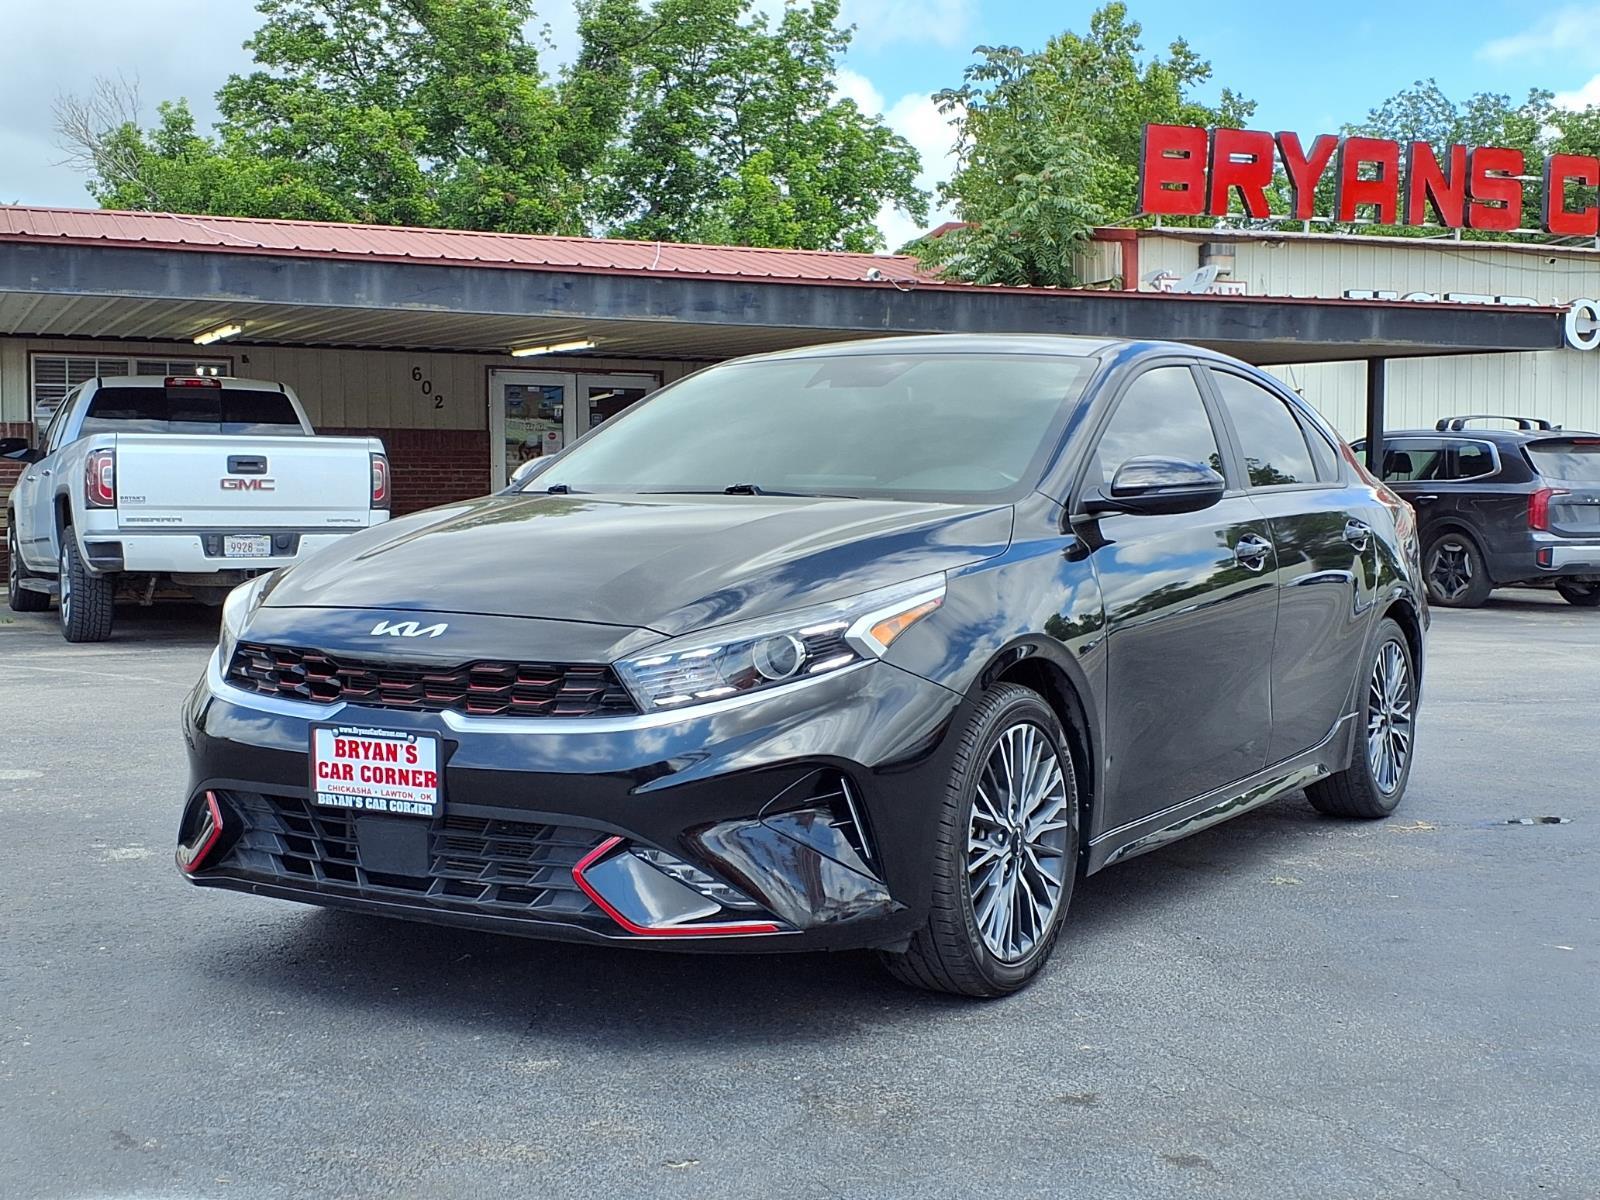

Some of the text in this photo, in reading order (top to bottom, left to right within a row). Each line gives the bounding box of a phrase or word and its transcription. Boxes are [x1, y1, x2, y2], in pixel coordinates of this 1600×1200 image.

[1138, 122, 1525, 232] BRYANS
[412, 366, 444, 409] 602
[220, 478, 275, 491] GMC
[370, 620, 449, 638] KIA
[334, 739, 418, 764] BRYAN'S
[318, 761, 437, 788] CAR CORNER
[317, 793, 364, 808] BRYAN'S
[365, 799, 387, 811] CAR
[327, 784, 372, 795] CHICKASHA
[420, 793, 432, 801] OK
